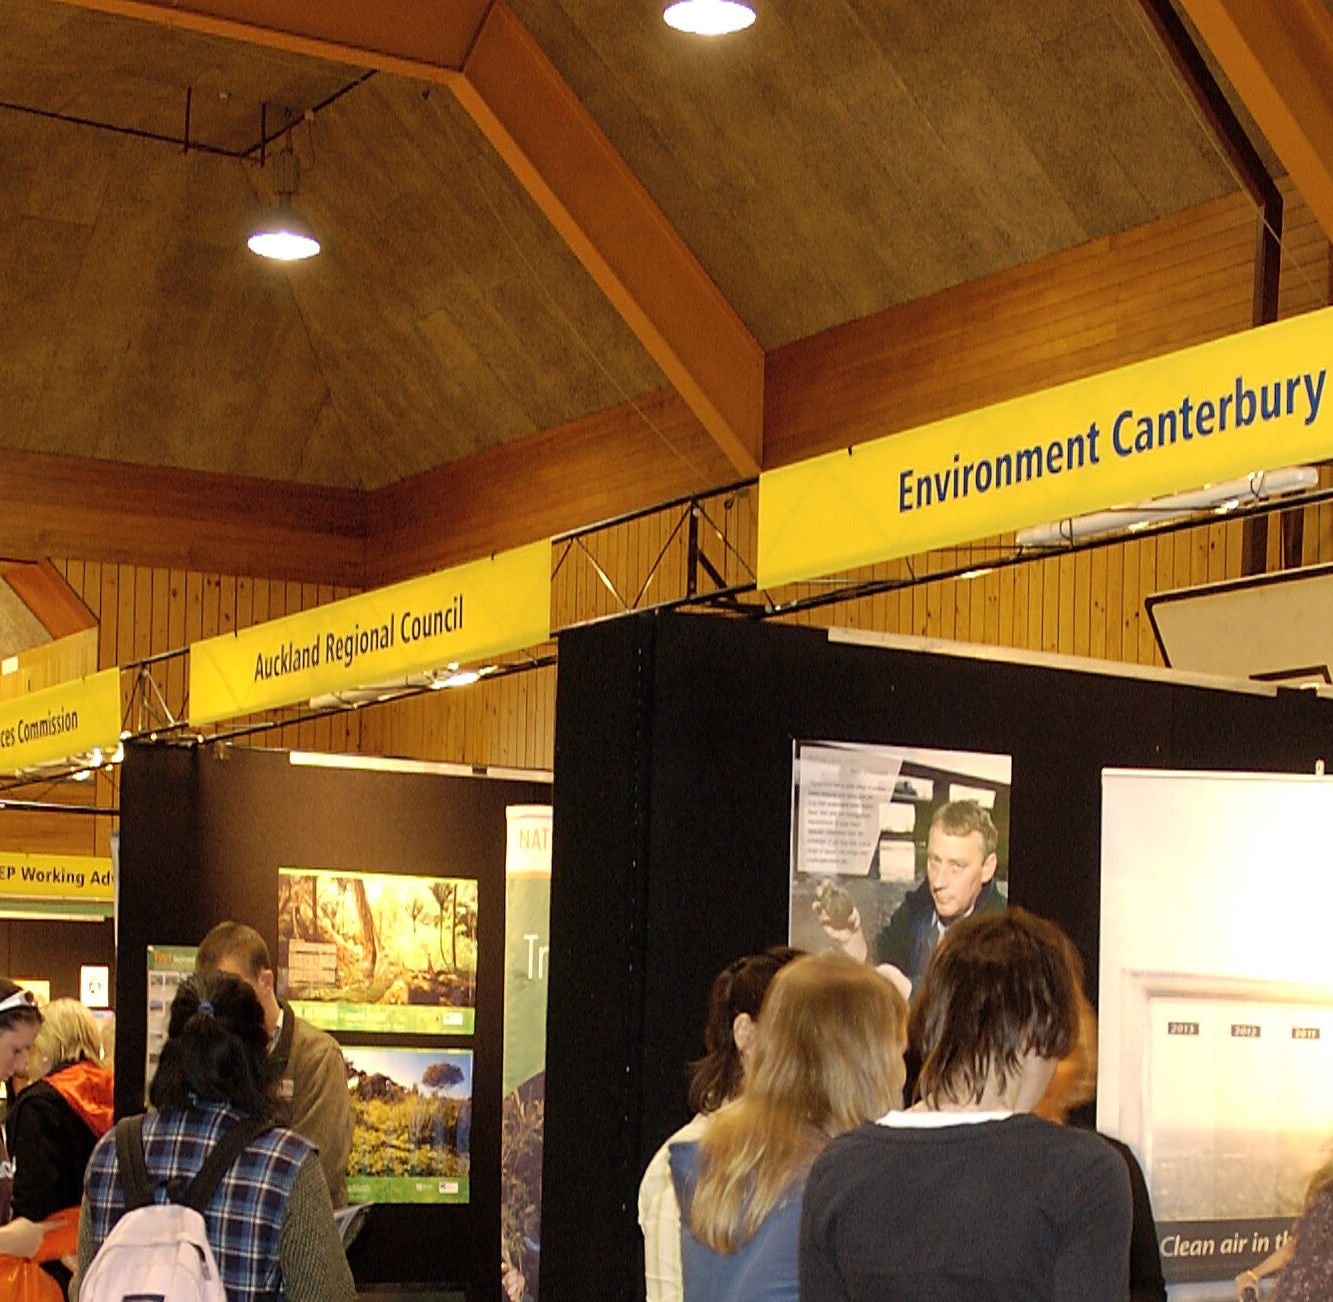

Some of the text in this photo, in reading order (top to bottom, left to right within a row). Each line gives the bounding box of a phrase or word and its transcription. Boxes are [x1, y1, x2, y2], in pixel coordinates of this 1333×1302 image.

[899, 369, 1327, 513] Environment Canterbury
[254, 594, 464, 682] Auckland Regional Council
[17, 705, 78, 743] Commission
[519, 828, 549, 850] NAT
[20, 866, 85, 888] Working
[90, 870, 115, 886] Ad
[1159, 1234, 1215, 1258] Clean
[1220, 1232, 1248, 1254] air
[1251, 1232, 1270, 1253] in
